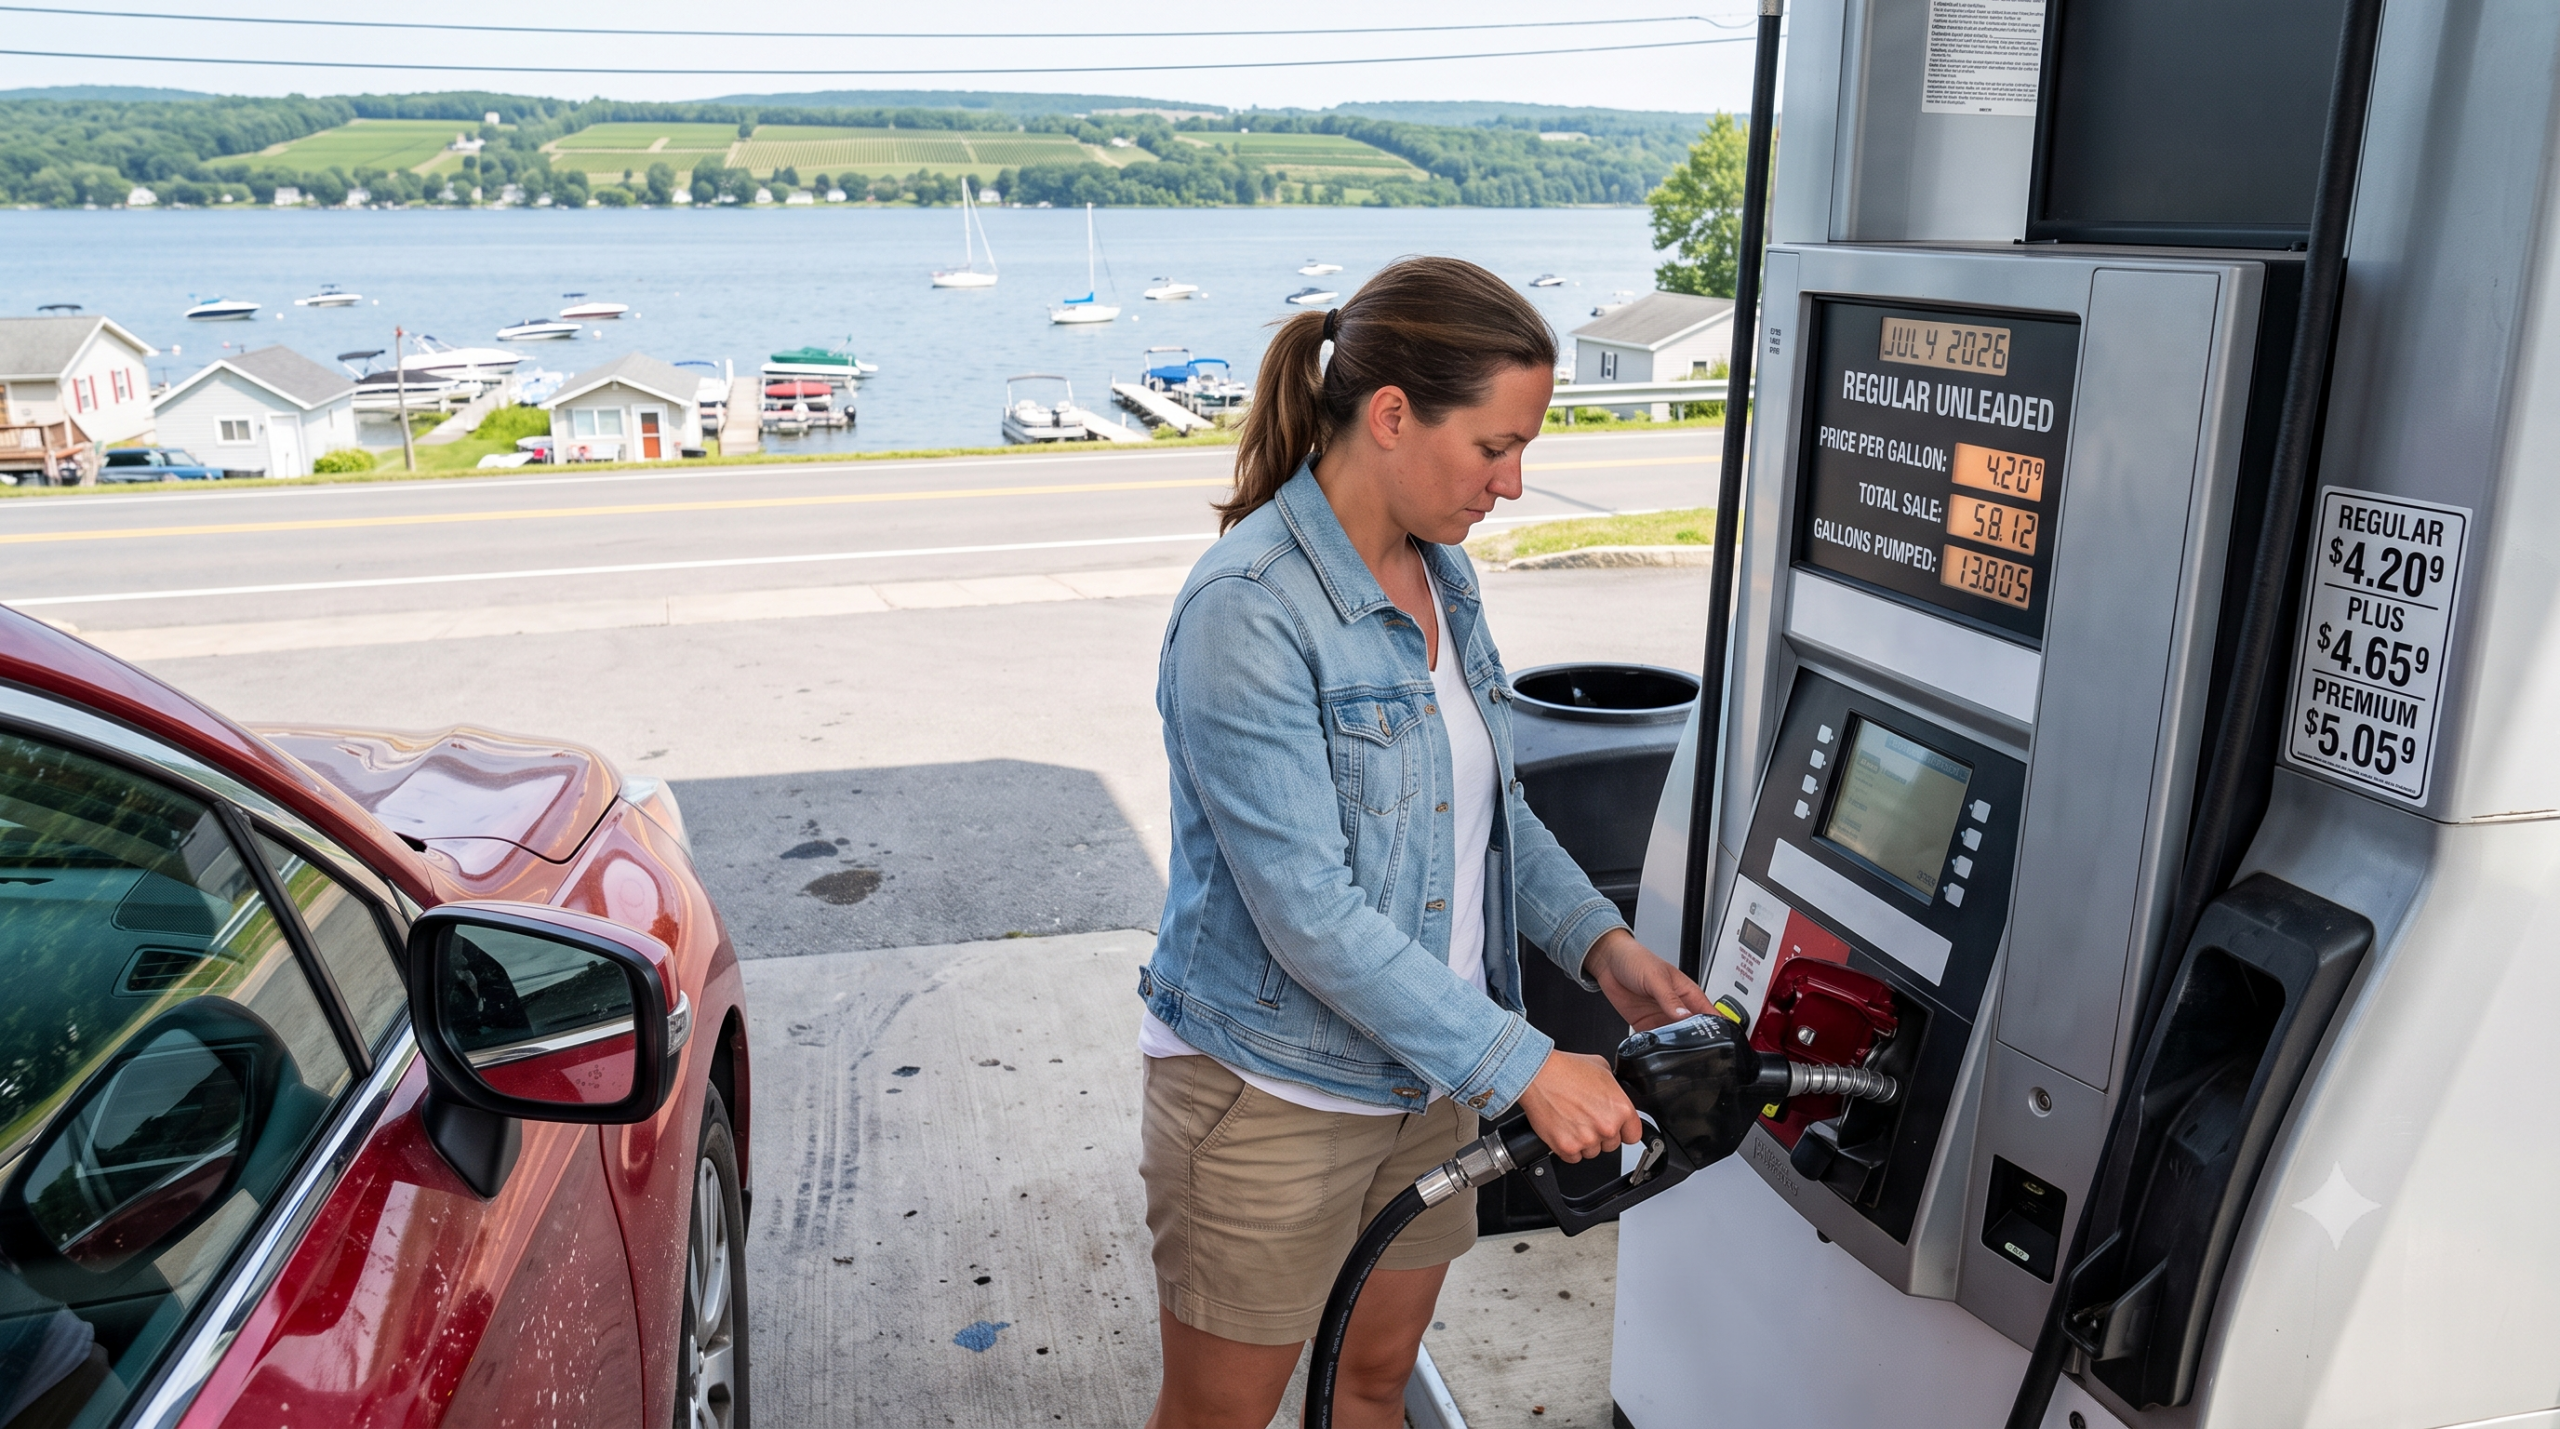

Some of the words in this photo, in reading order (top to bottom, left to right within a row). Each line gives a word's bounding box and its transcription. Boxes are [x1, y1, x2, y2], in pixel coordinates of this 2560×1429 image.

[1946, 329, 2008, 370] 2026
[1842, 370, 1931, 414] REGULAR
[1936, 383, 2055, 433] UNLEADED
[1819, 425, 1857, 453] PRICE
[1858, 433, 1885, 459] PER
[1887, 440, 1947, 473] GALLON:
[1858, 481, 1899, 513] TOTAL
[1902, 492, 1943, 524] SALE:
[1973, 503, 2036, 549] 58.12
[2338, 504, 2445, 548] REGULAR
[1813, 517, 1872, 553] GALLONS
[1873, 533, 1937, 573] PUMPED:
[1959, 555, 2029, 603] 13.805
[2347, 596, 2406, 633] PLUS
[2312, 677, 2419, 730] PREMIUM
